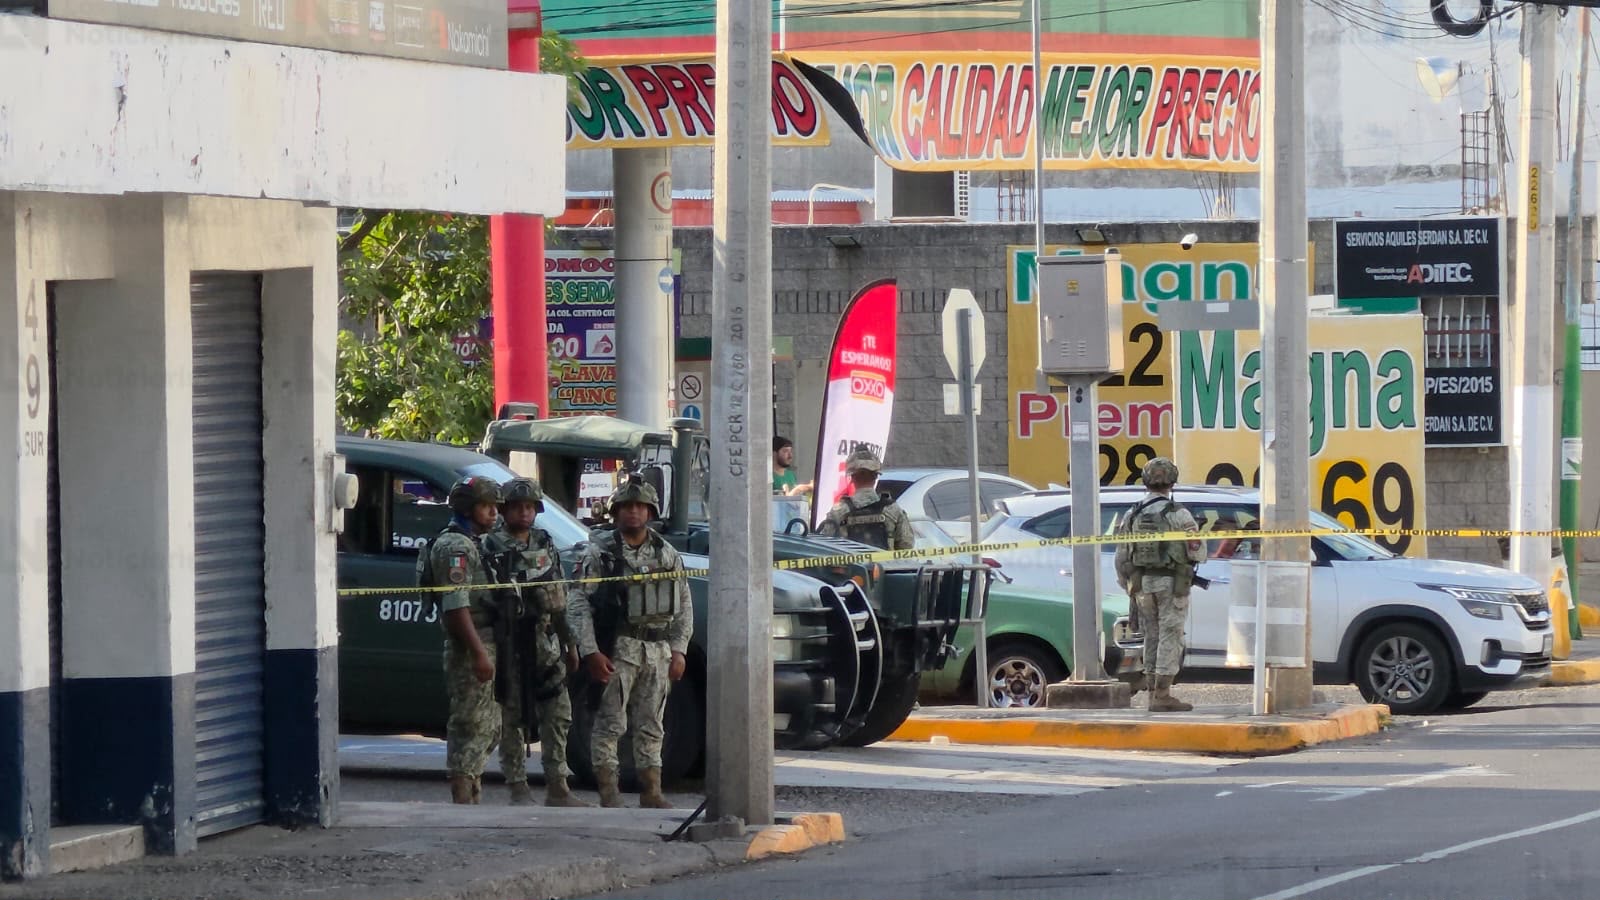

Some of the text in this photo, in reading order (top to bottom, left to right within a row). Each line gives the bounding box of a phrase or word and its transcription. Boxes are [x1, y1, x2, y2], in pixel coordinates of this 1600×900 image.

[902, 63, 1034, 160] CALIDAD
[1042, 66, 1153, 160] MEJOR
[1145, 68, 1261, 162] PRECIO
[1346, 229, 1489, 247] SERVICIOS AQUILES SERDAN S.A. DE C.V.
[573, 309, 602, 318] CENTRO
[840, 351, 892, 372] ESPERAMOS!
[851, 376, 886, 398] OXXO
[729, 415, 743, 444] PCR
[1451, 416, 1466, 432] S.A.
[1467, 416, 1479, 432] DE
[1479, 416, 1494, 432] C.V.
[24, 431, 45, 456] SUR
[729, 447, 743, 477] CFE
